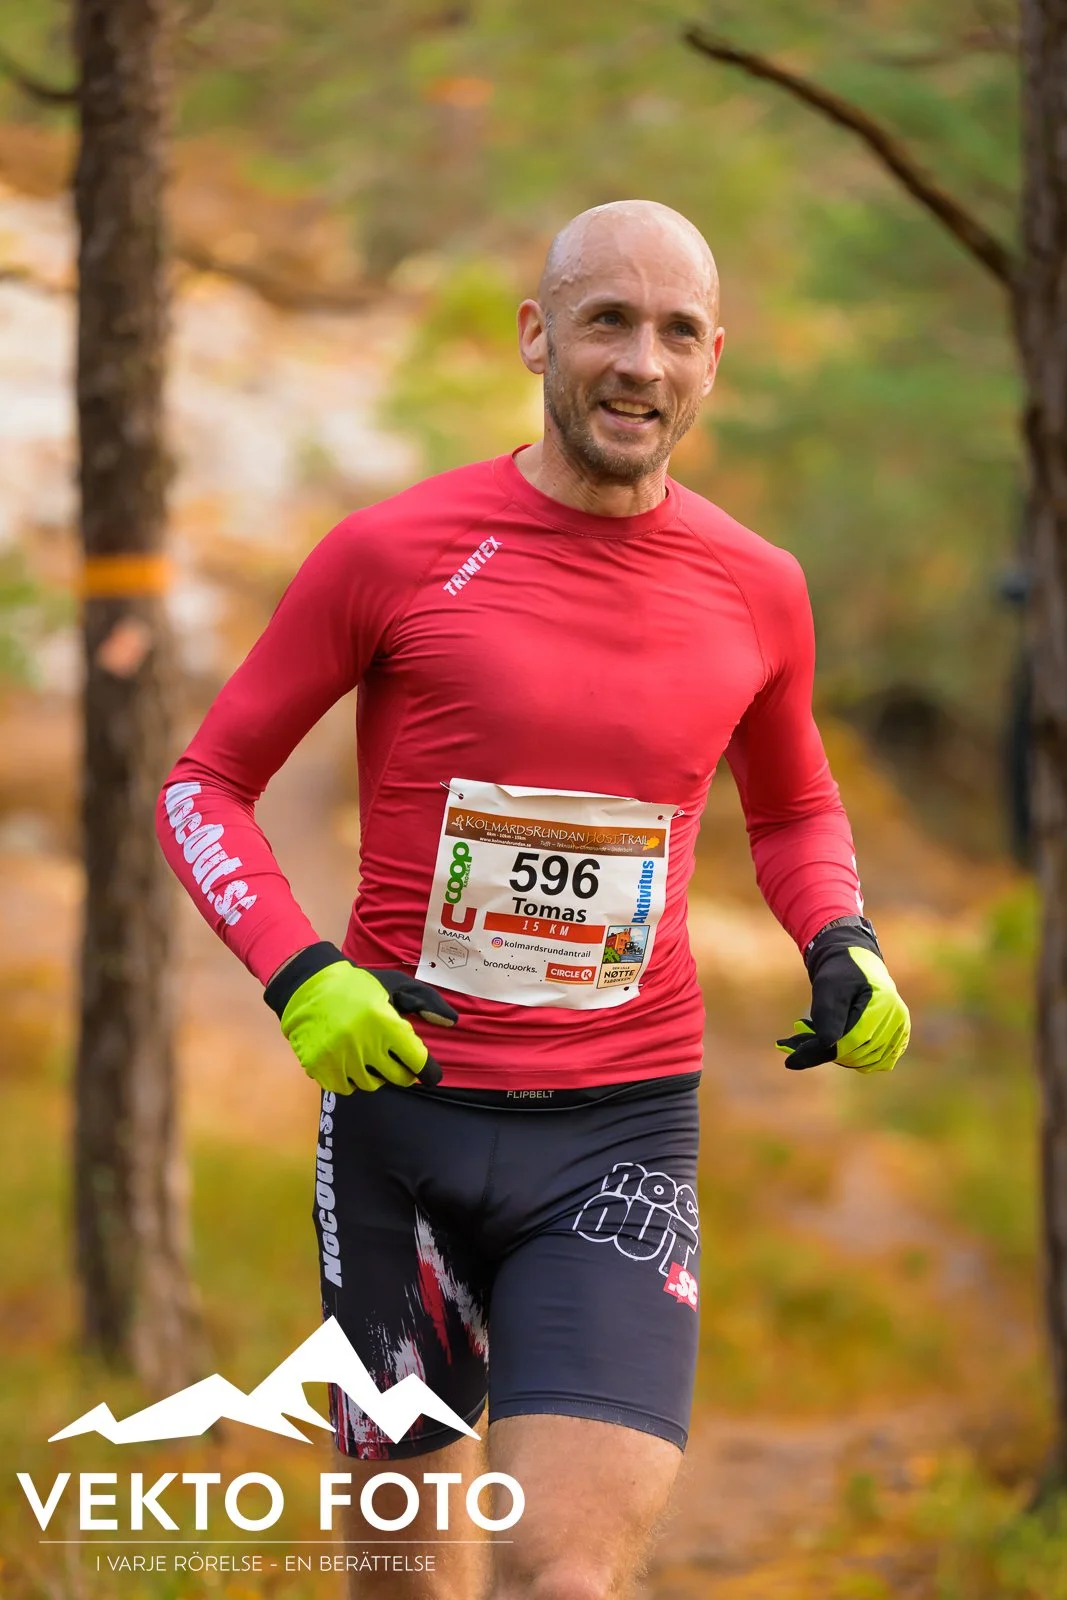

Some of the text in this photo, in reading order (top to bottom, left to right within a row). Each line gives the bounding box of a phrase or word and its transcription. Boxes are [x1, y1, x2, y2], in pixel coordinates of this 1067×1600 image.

[443, 536, 503, 596] TRIMTEX
[445, 841, 472, 904] coop
[509, 852, 600, 899] 596
[632, 860, 654, 924] Aktivitus
[512, 897, 587, 923] Tomas
[438, 928, 471, 942] UMARA
[522, 920, 570, 936] 15 KM
[504, 940, 591, 958] kolmardsrundantrail
[550, 968, 592, 980] CIRCLE K
[604, 970, 635, 978] NØTTE
[506, 1090, 555, 1099] FLIPBELT
